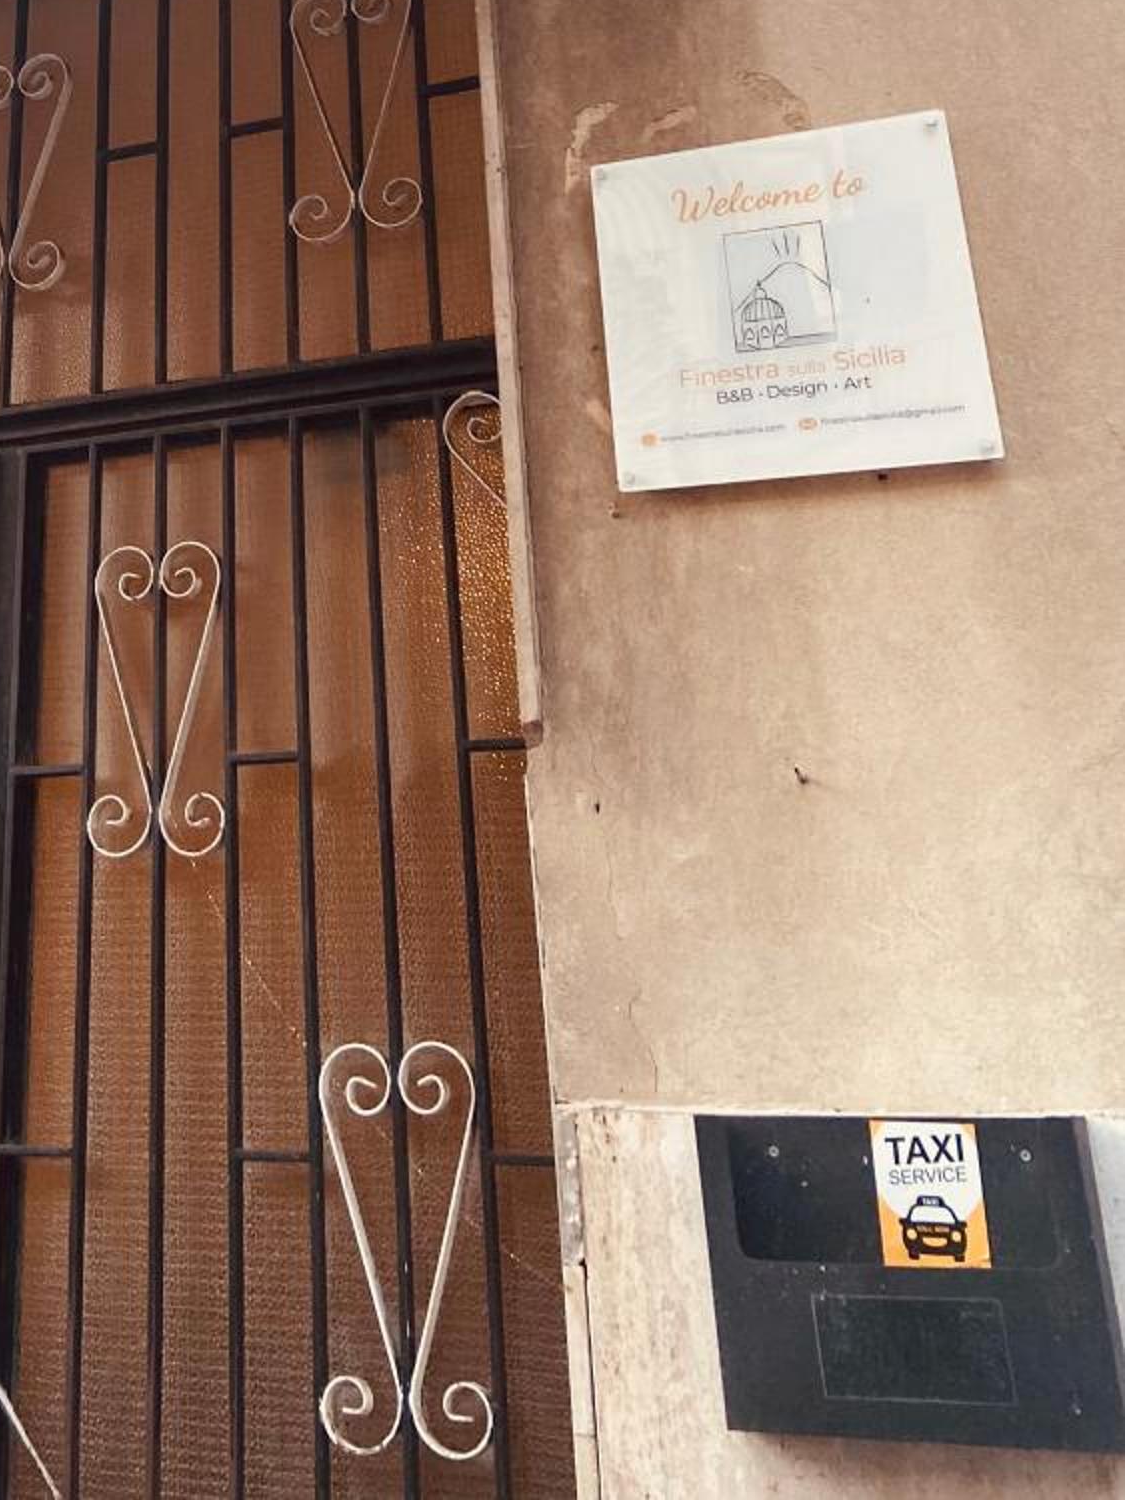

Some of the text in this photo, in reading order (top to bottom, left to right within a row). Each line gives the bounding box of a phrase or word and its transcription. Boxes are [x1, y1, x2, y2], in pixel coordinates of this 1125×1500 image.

[671, 169, 865, 223] Welcome to
[679, 346, 907, 388] Finestra sulla Sicilia
[716, 375, 872, 404] B&B Design Art
[885, 1133, 965, 1165] TAXI
[888, 1167, 968, 1185] SERVICE
